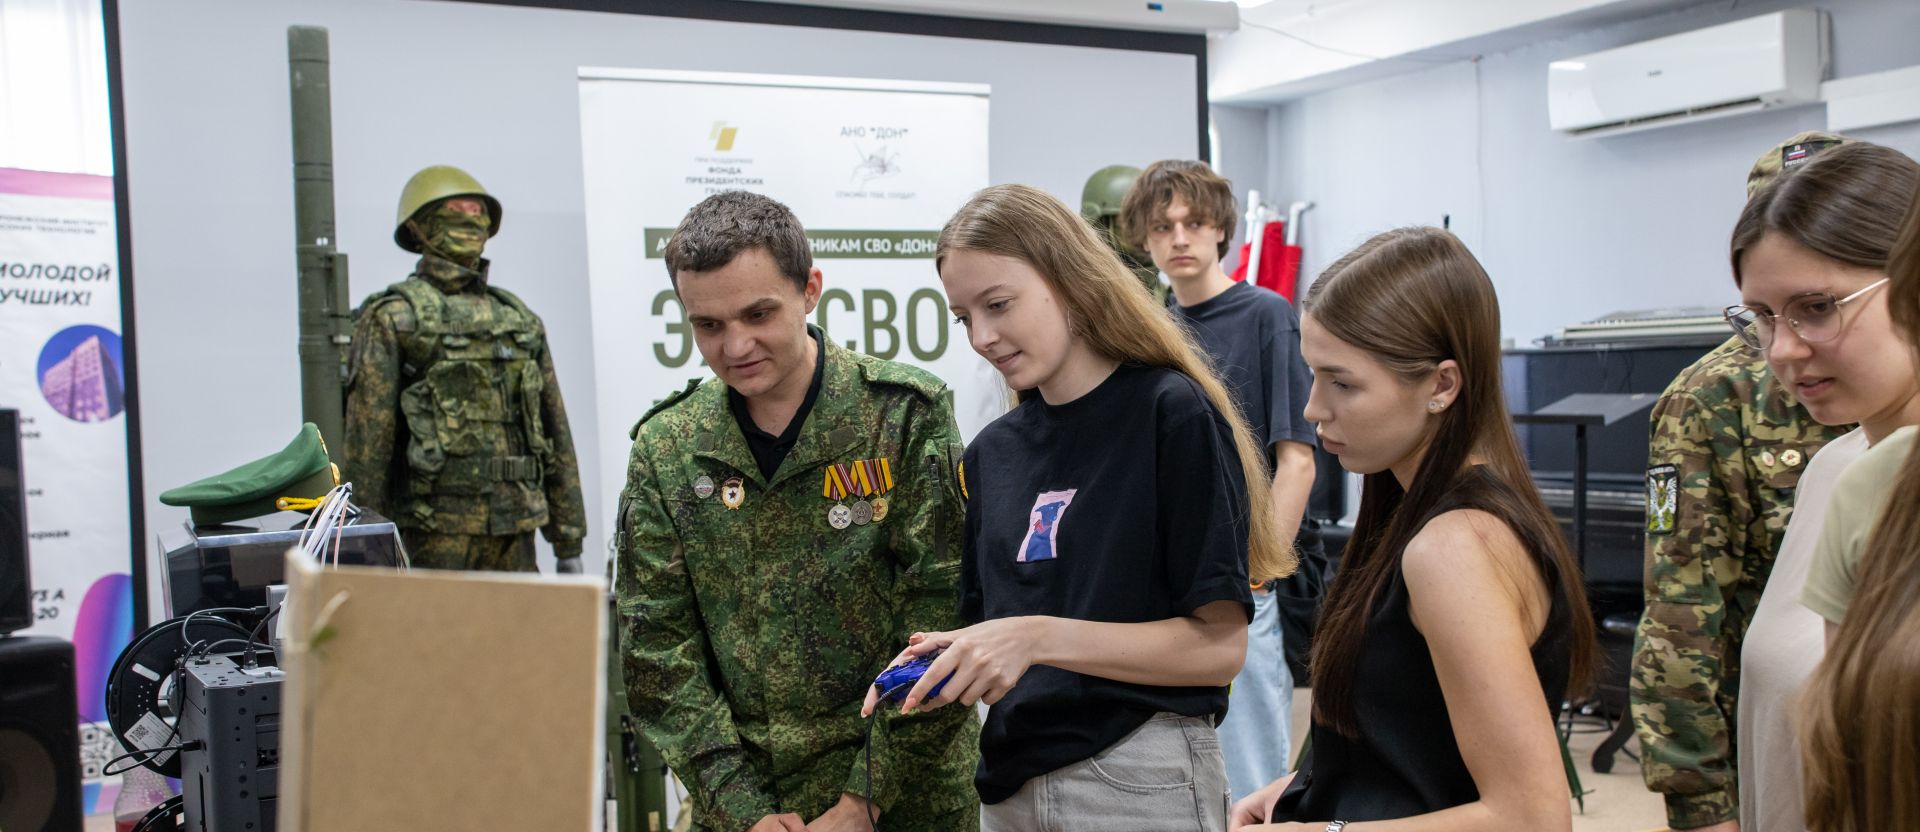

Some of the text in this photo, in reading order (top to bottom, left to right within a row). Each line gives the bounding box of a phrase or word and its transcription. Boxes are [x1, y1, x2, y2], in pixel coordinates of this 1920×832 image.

[840, 126, 866, 137] АНО
[707, 166, 743, 175] ФОНДА
[685, 176, 764, 186] ПРЕЗИДЕНТСКИХ
[807, 237, 862, 253] НИКАМ
[863, 238, 892, 253] СВО
[816, 287, 949, 362] СВО
